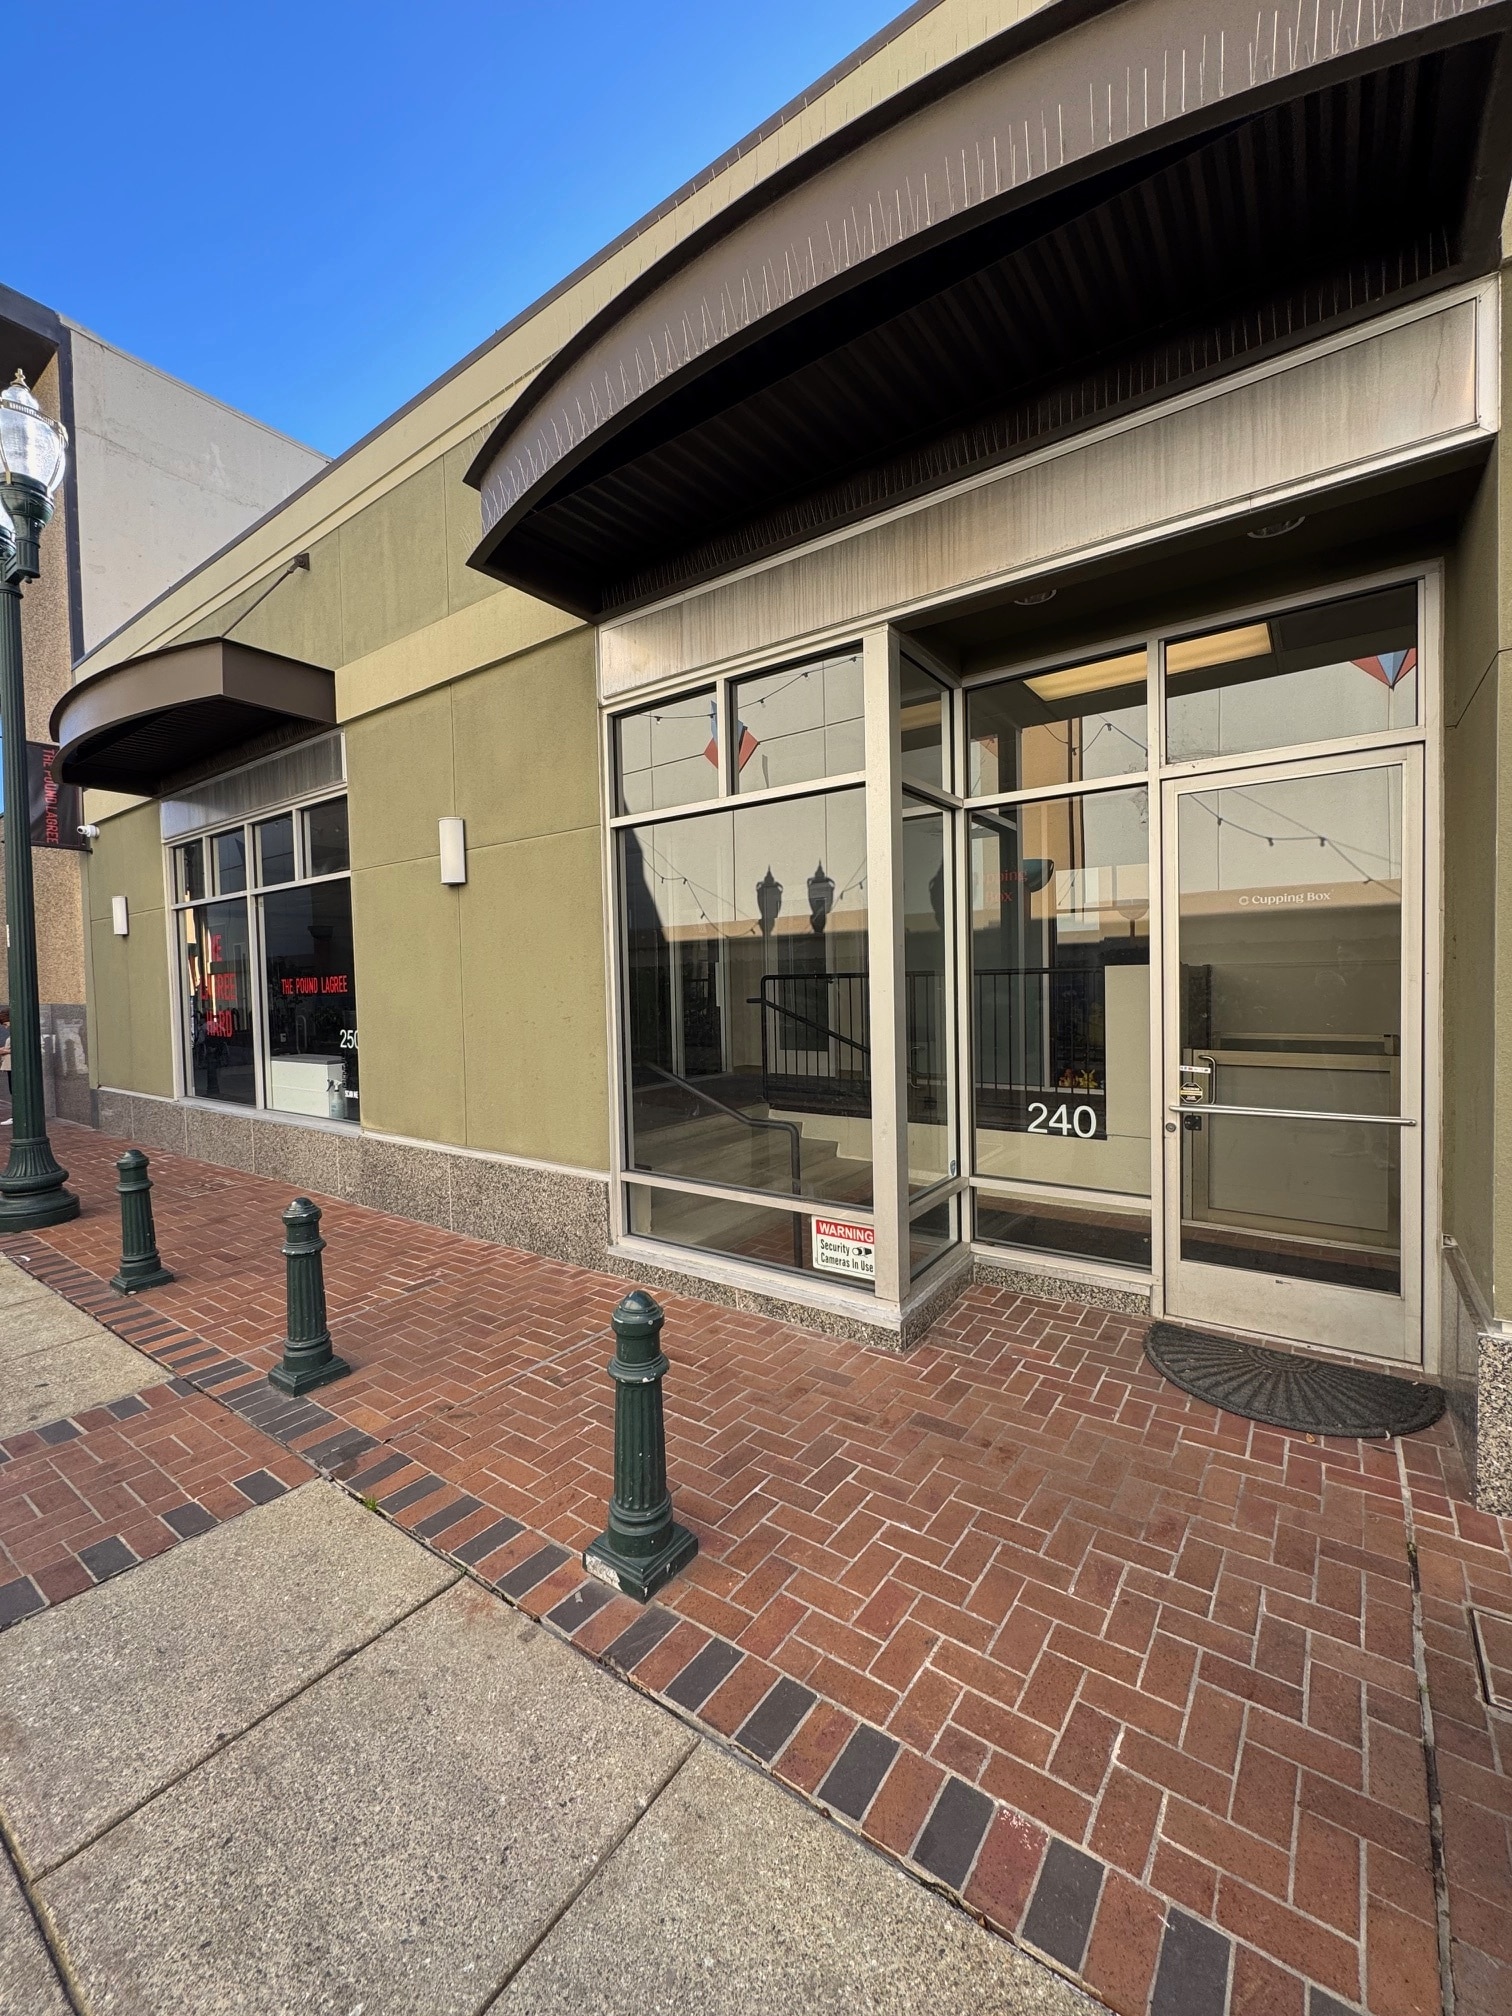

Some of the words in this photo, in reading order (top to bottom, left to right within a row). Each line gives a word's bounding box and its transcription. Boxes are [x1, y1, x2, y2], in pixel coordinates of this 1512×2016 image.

[45, 804, 59, 845] LAGREE
[1251, 892, 1305, 906] Cupping
[1306, 891, 1331, 902] Box
[199, 973, 237, 1001] LREE
[281, 977, 294, 995] THE
[295, 977, 318, 994] POUND
[320, 974, 348, 993] LAGREE
[1027, 1102, 1097, 1138] 240
[818, 1221, 874, 1243] WARNING
[820, 1238, 850, 1256] Security
[820, 1252, 850, 1268] Cameras
[852, 1258, 858, 1270] In
[860, 1260, 874, 1272] Use
